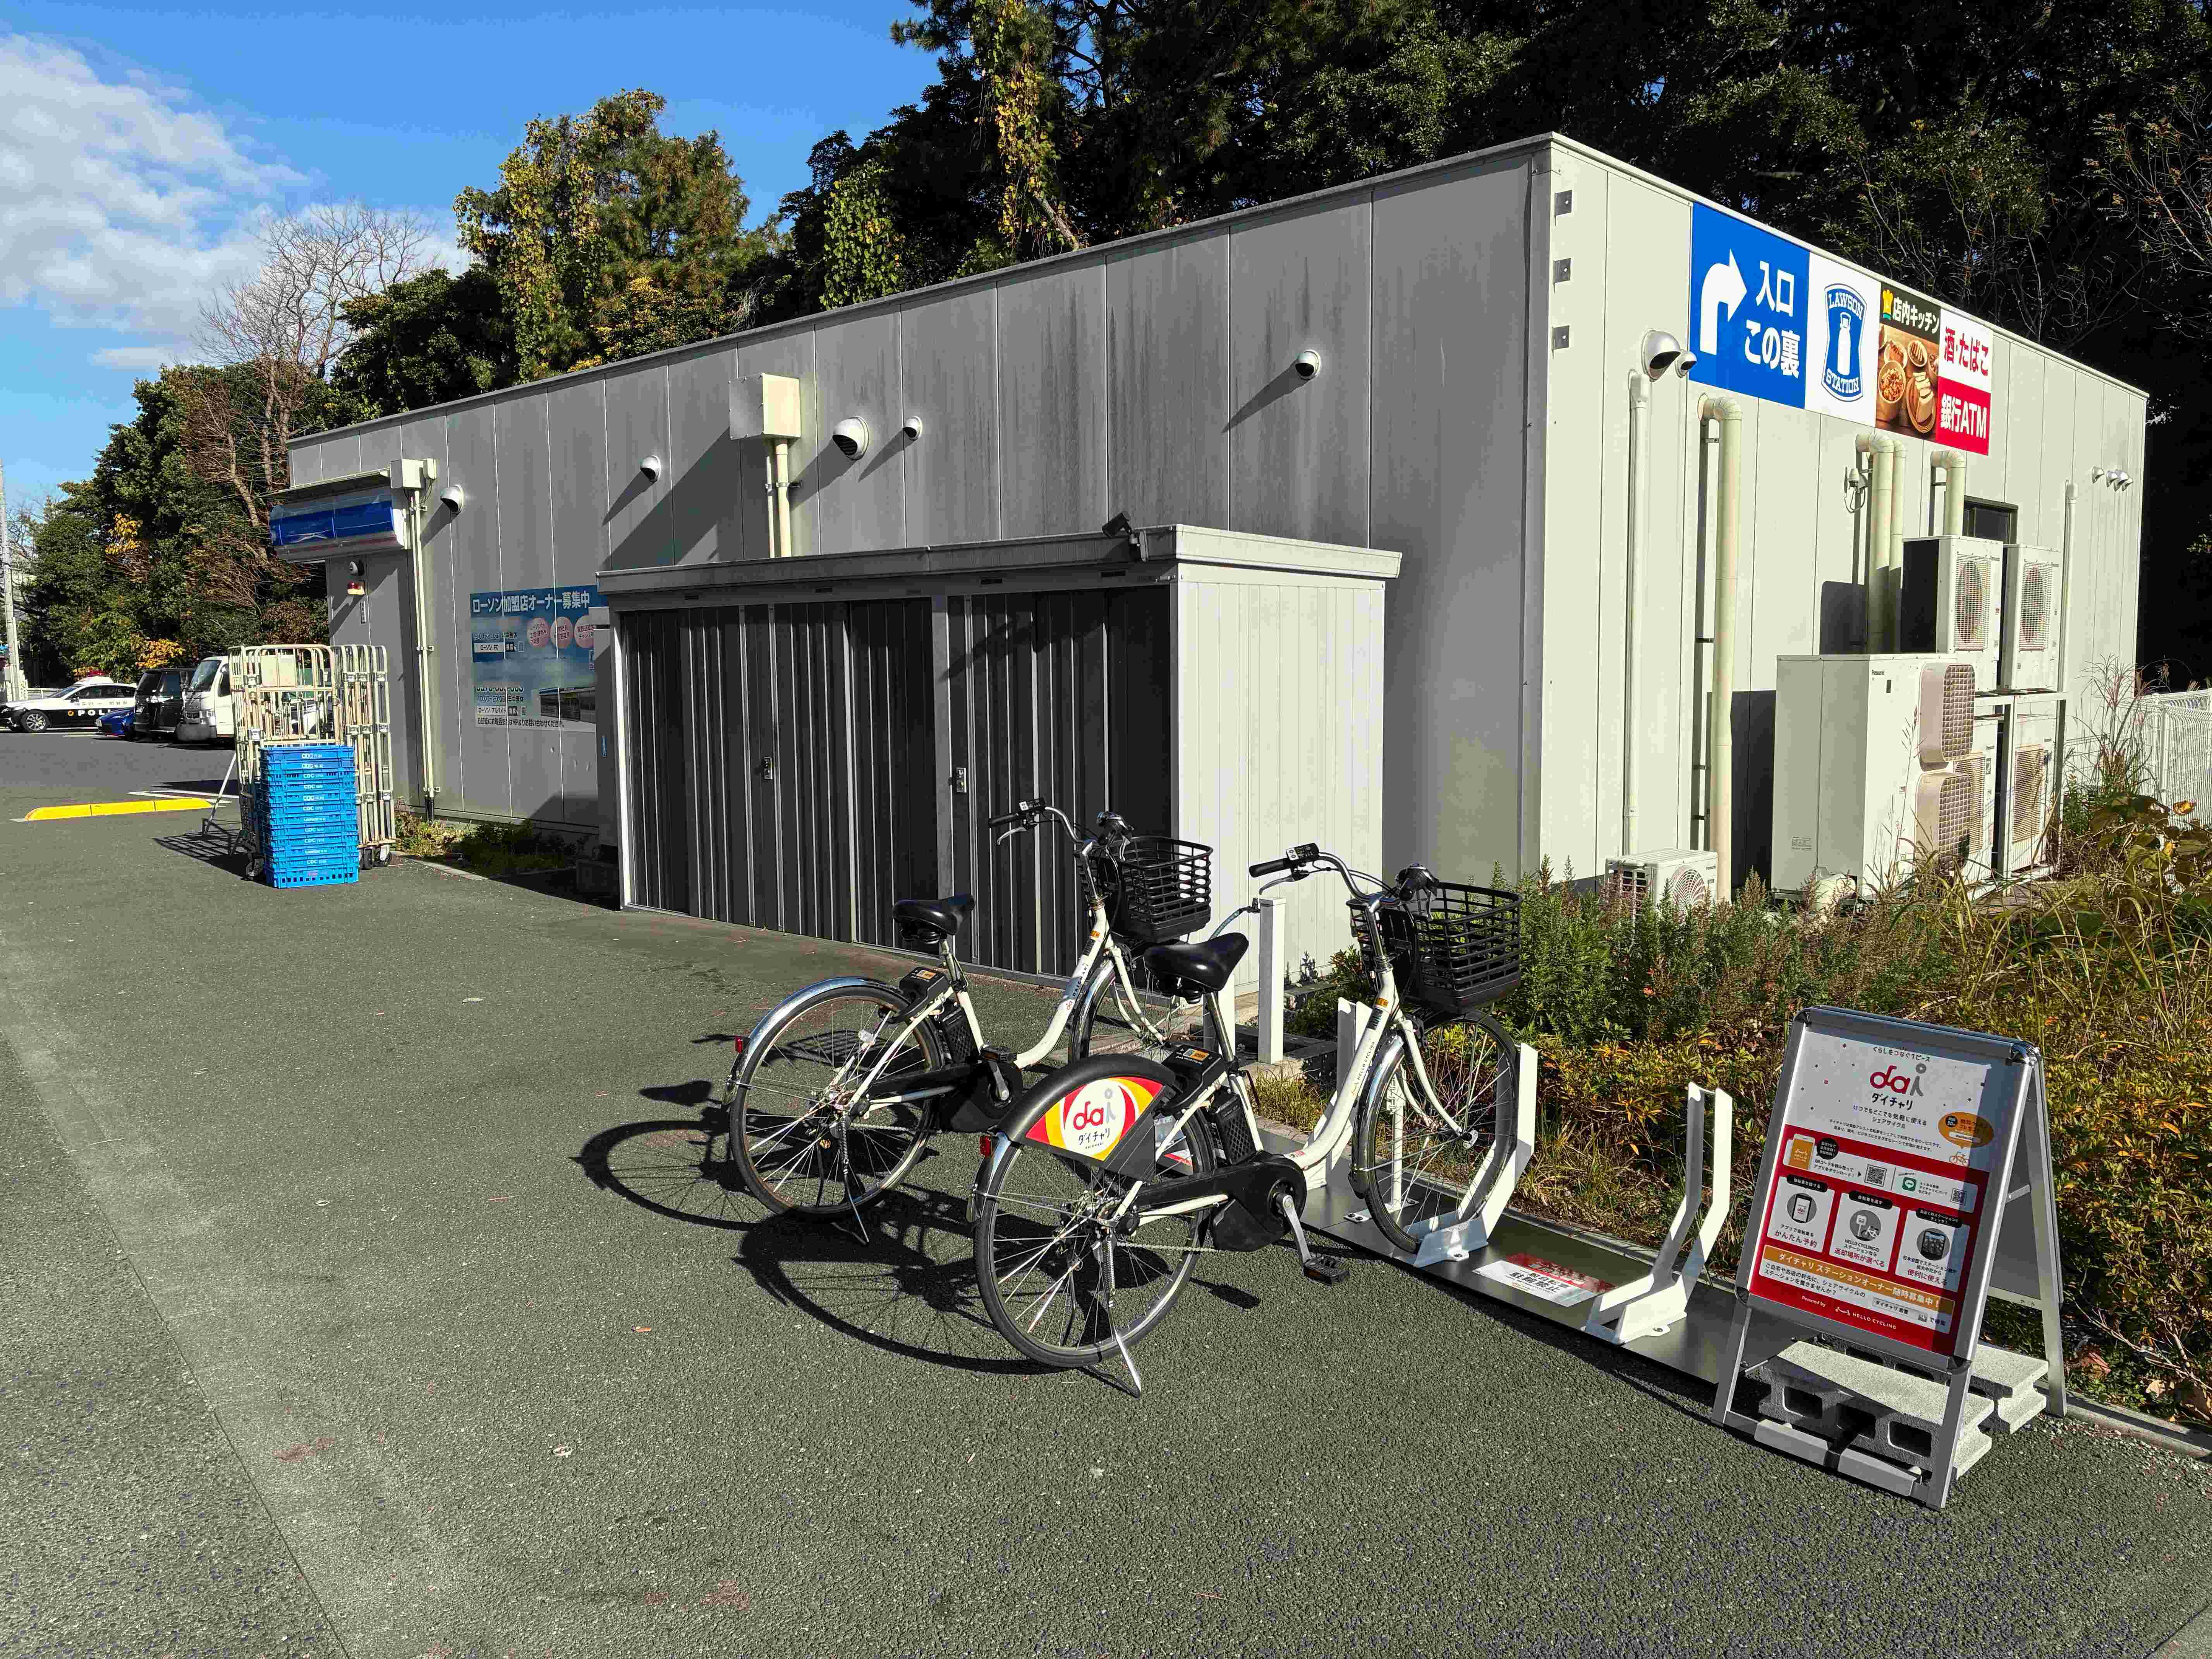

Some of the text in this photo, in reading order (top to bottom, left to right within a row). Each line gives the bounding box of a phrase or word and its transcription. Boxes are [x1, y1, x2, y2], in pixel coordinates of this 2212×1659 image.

[1756, 261, 1795, 317] 入口
[1828, 292, 1864, 320] LAWSON
[1893, 297, 1939, 334] 店内キッチン
[1745, 319, 1800, 378] この裏
[1945, 328, 1989, 376] 酒・たばこ
[1826, 369, 1859, 393] STATION
[1941, 393, 1987, 439] 銀行ATM
[473, 591, 590, 613] ローソン加盟店オーナー募集中
[1873, 1047, 1930, 1063] くらしをつなぐ1ピース
[1870, 1063, 1927, 1097] dai
[1073, 1088, 1116, 1130] dai
[1872, 1092, 1913, 1111] ダイチャリ
[1853, 1104, 1927, 1126] いつでもどこでも気軽に使える
[1872, 1116, 1906, 1129] シェアサイクル
[1079, 1128, 1110, 1146] ダイチャリ
[1774, 1230, 1817, 1248] かんたん予約
[1781, 1224, 1814, 1237] アプリで自転車を
[1834, 1247, 1885, 1268] 返却場所が選べる
[1844, 1244, 1877, 1257] ステーションなら
[1778, 1253, 1815, 1270] ダイチャリ
[1764, 1269, 1836, 1295] ステーションを置きませんか？
[1765, 1263, 1866, 1298] ご自宅やお店の軒先に、シェアサイクルの
[1908, 1269, 1947, 1286] 便利に使える
[1802, 1295, 1820, 1305] Powered
[1875, 1300, 1899, 1311] ダイチャリ
[1852, 1313, 1897, 1329] HELLO CYCLING
